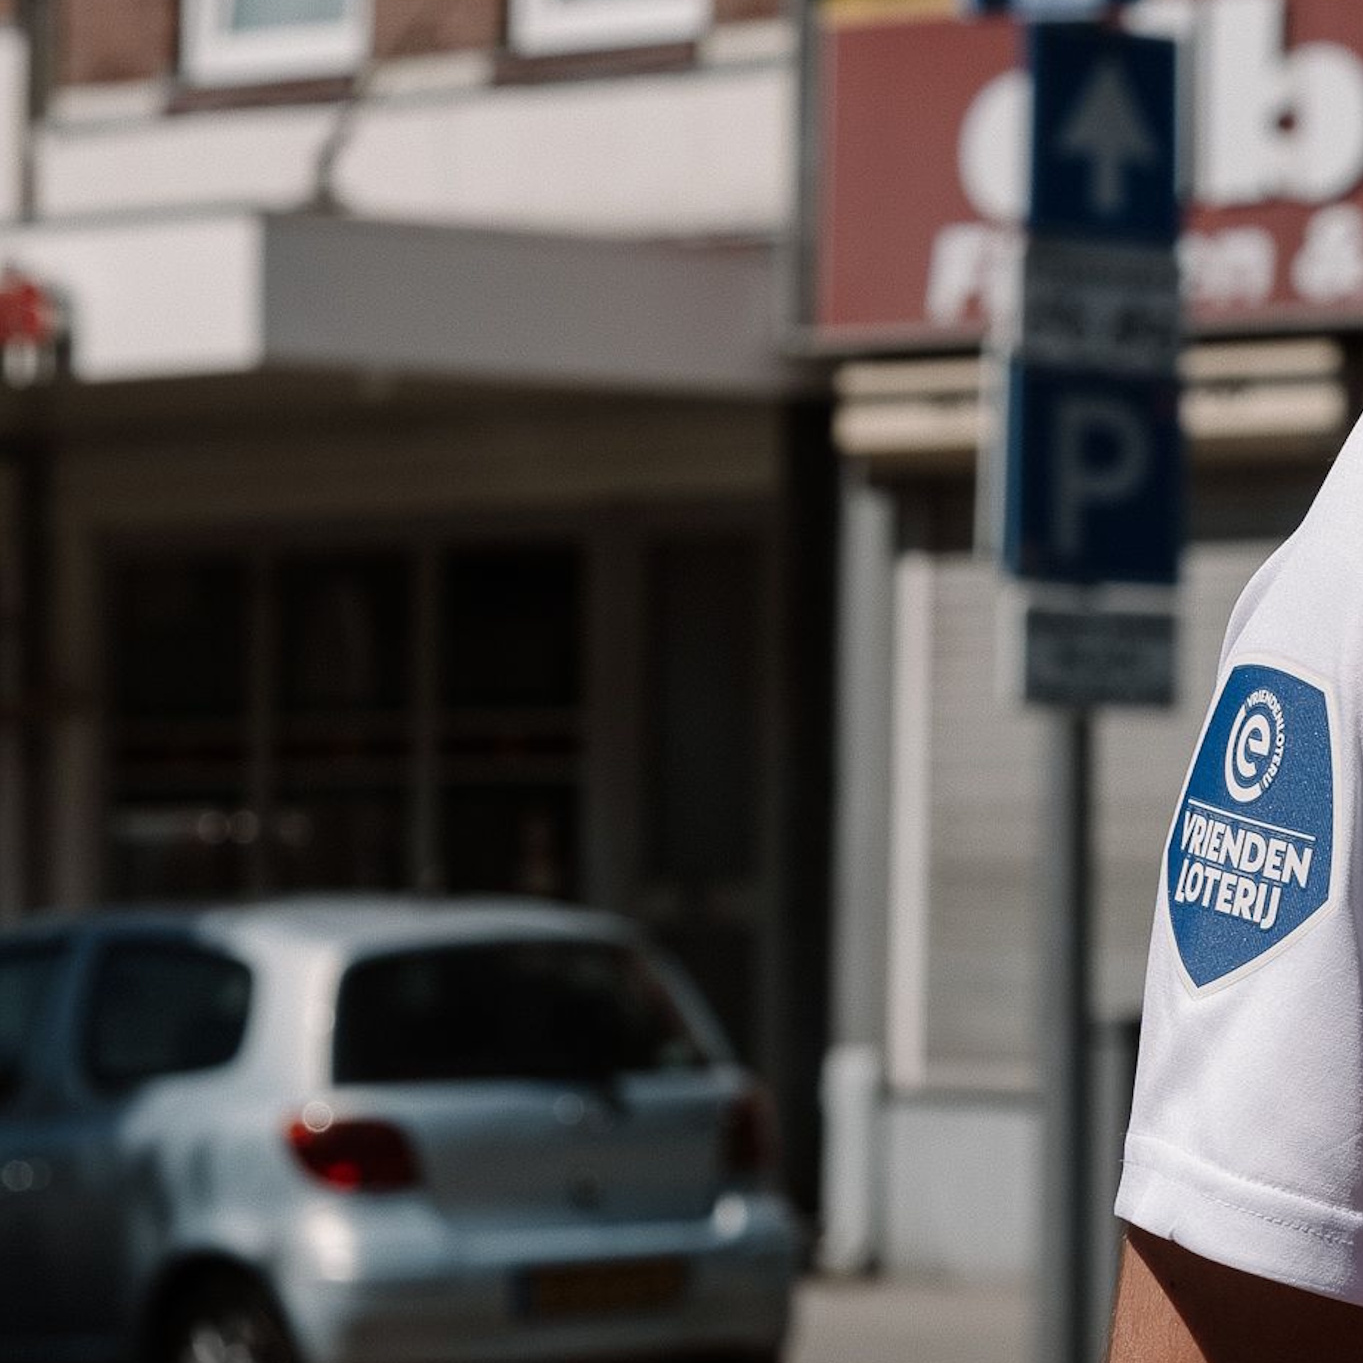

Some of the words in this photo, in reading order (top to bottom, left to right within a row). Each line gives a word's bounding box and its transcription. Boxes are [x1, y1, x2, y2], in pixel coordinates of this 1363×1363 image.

[1050, 394, 1150, 557] P
[1180, 810, 1314, 888] VRIENDEN
[1174, 859, 1282, 930] LOTERIJ
